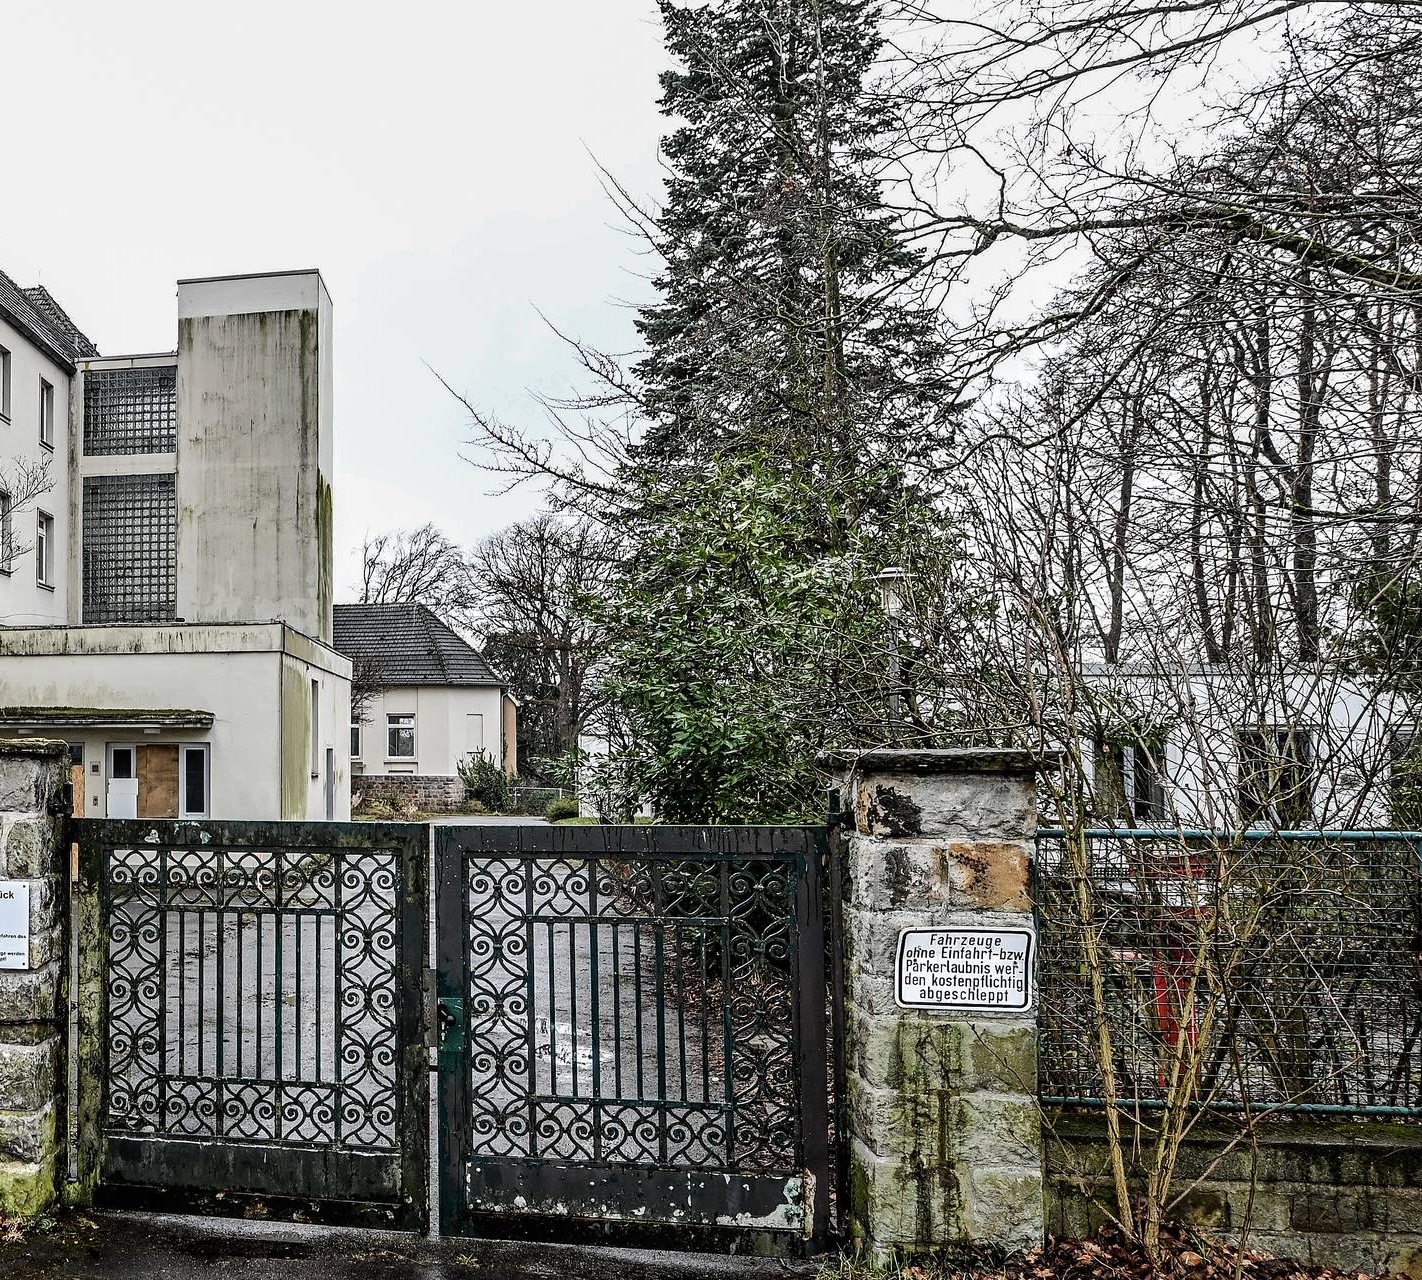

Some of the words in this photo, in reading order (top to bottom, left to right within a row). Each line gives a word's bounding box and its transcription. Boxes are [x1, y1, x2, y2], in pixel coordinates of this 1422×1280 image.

[929, 934, 1002, 949] Fahrzeuge
[906, 946, 936, 958] ohne
[906, 959, 991, 974] Parkerlaubnis
[994, 964, 1024, 975] wer-
[904, 973, 926, 986] den
[931, 973, 1024, 992] kostenpflichtig
[919, 986, 1009, 1003] abgeschleppt
